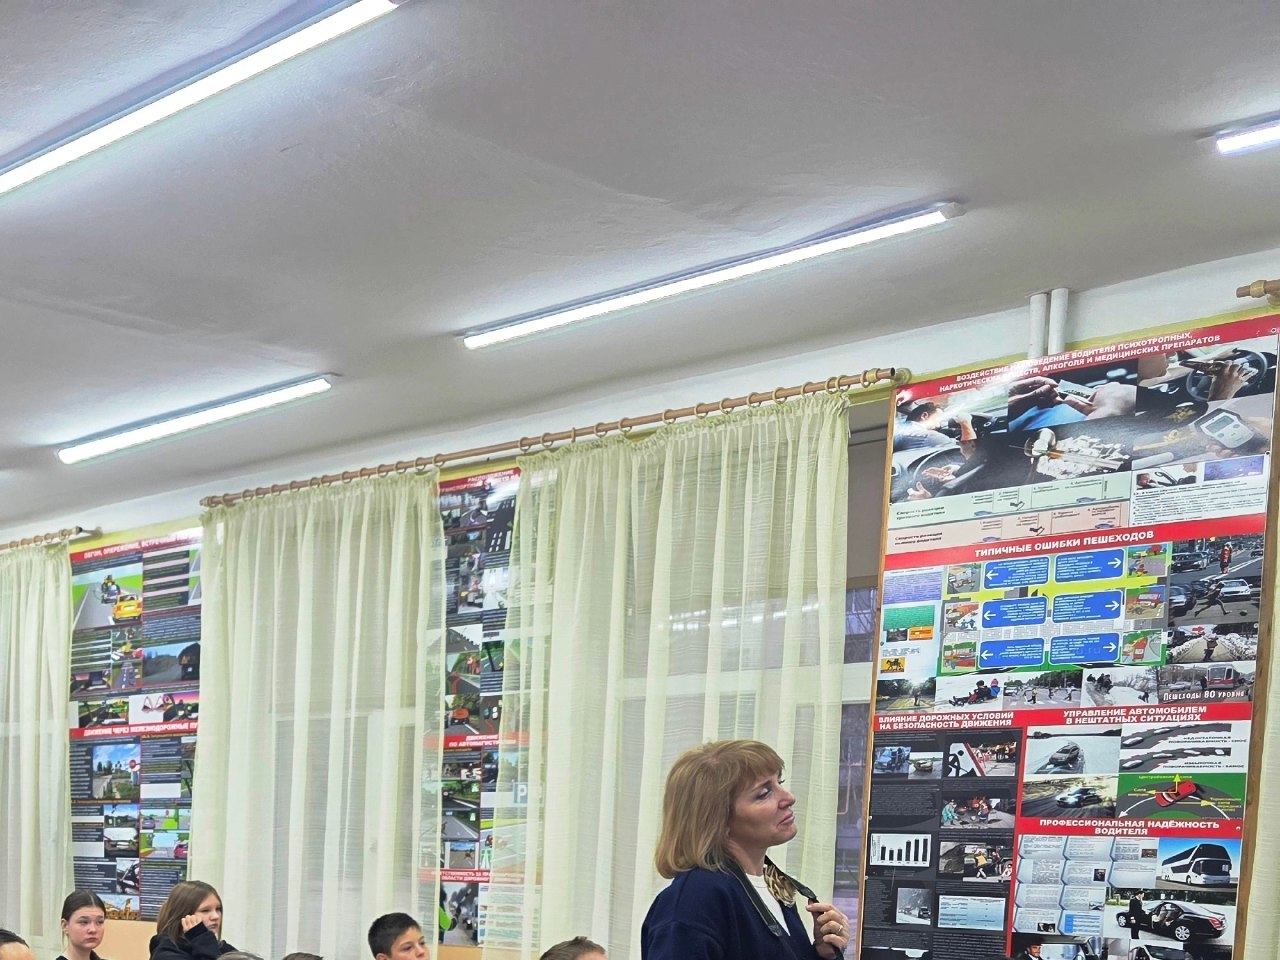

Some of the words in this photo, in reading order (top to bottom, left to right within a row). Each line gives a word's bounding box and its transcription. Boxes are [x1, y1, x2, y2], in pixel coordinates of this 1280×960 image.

[956, 364, 1009, 382] ВОЗДЕЙСТВИЕ
[1072, 345, 1116, 361] ВОДИТЕЛЯ
[1117, 331, 1193, 352] ПСИХОТРОПНЫХ,
[1042, 358, 1084, 372] АЛКОГОЛЯ
[1094, 345, 1160, 363] МЕДИЦИНСКИХ
[1160, 334, 1221, 352] ПРЕПАРАТОВ
[974, 544, 1032, 557] ТИПИЧНЫЕ
[1034, 539, 1081, 551] ОШИБКИ
[1083, 530, 1155, 546] ПЕШЕХОДОВ
[1203, 690, 1216, 699] 80
[878, 715, 918, 723] ВЛИЯНИЕ
[919, 712, 970, 723] ДОРОЖНЫХ
[972, 711, 1014, 720] УСЛОВИЙ
[1063, 709, 1126, 718] УПРАВЛЕНИЕ
[1128, 706, 1207, 716] АВТОМОБИЛЕМ
[893, 720, 959, 730] БЕЗОПАСНОСТЬ
[960, 719, 1012, 728] ДВИЖЕНИЯ
[1074, 715, 1137, 725] НЕШТАТНЫХ
[1140, 713, 1202, 723] СИТУАЦИЯХ
[1039, 819, 1145, 828] ПРОФЕССИОНАЛЬНАЯ
[1147, 819, 1220, 829] НАДЁЖНОСТЬ
[1094, 827, 1148, 836] ВОДИТЕЛЯ
